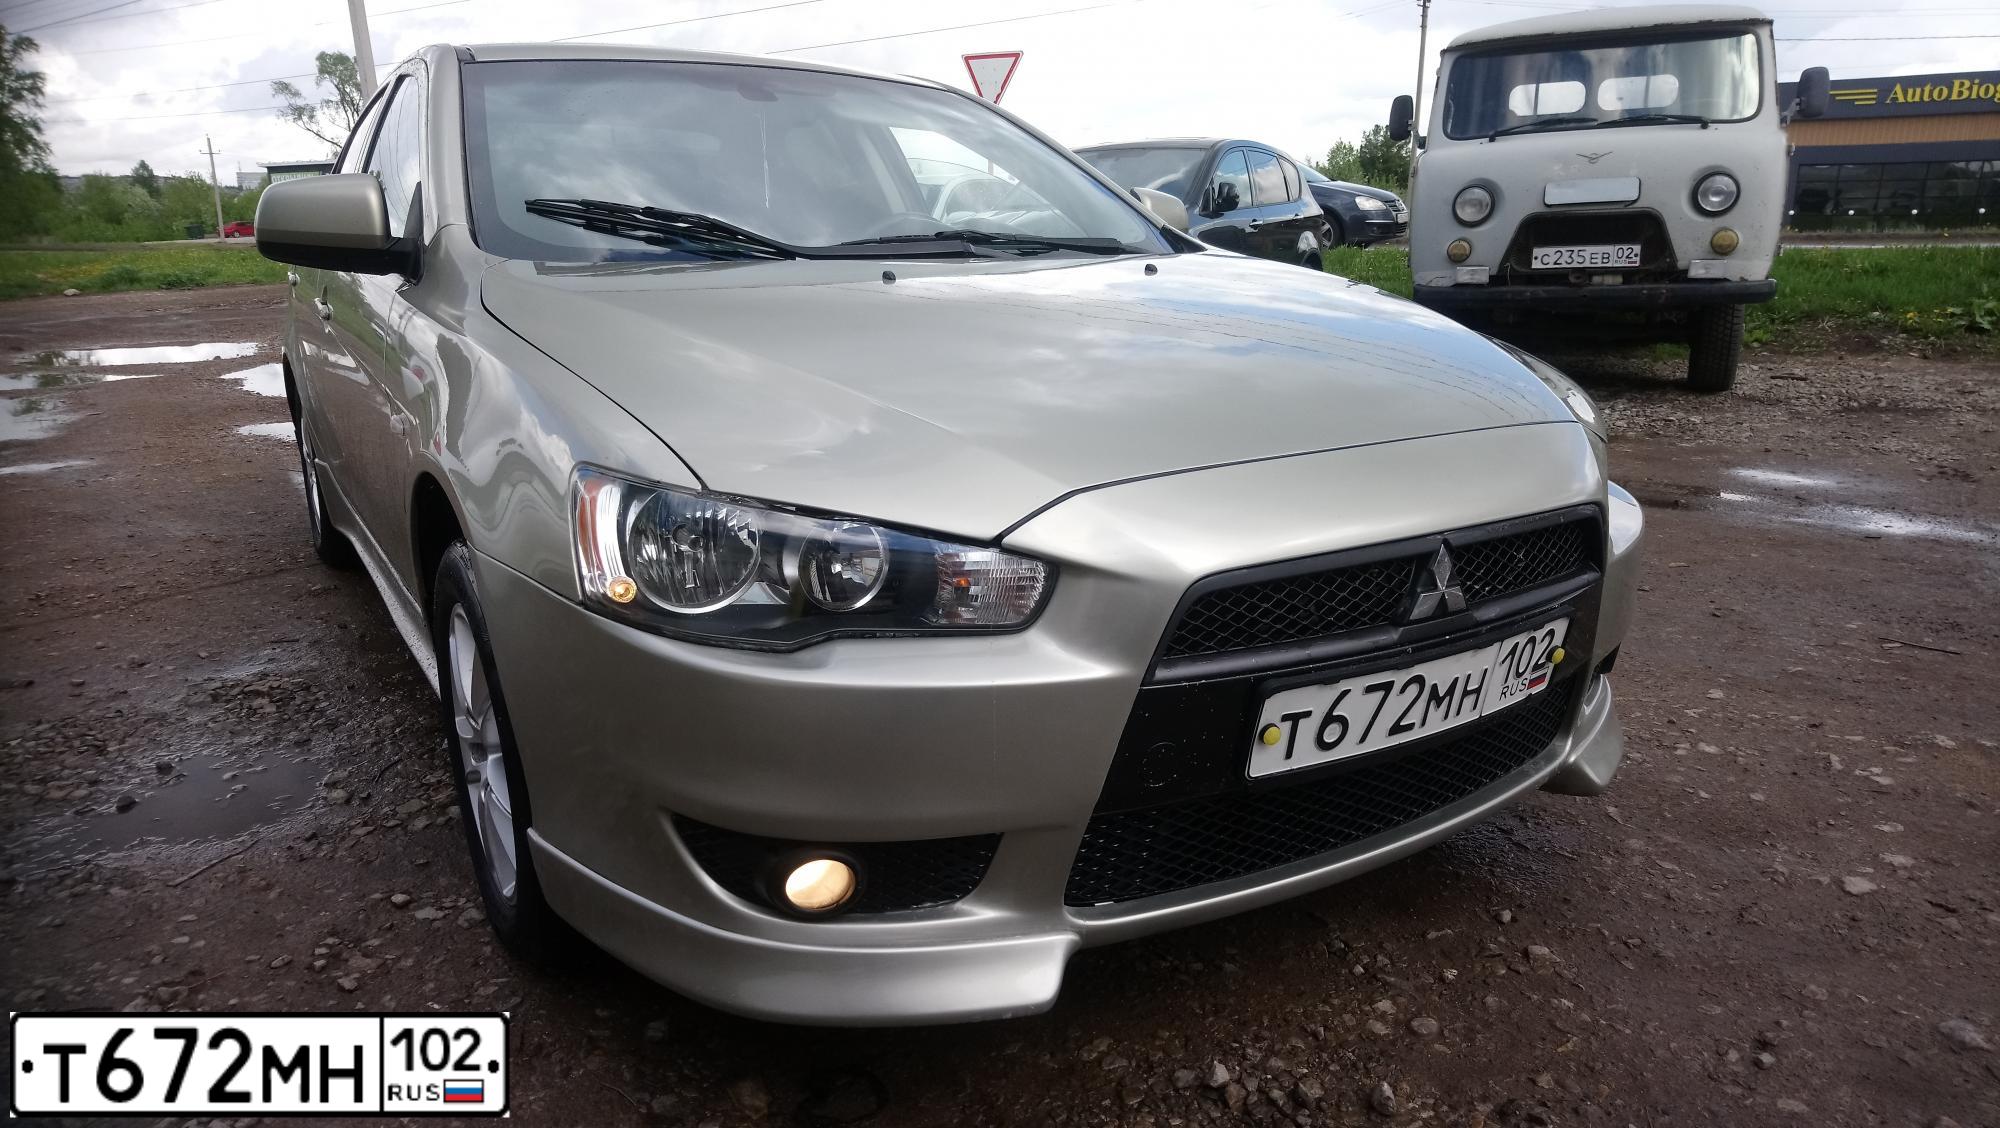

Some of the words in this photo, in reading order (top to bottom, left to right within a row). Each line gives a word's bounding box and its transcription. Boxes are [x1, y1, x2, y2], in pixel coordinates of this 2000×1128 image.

[1616, 246, 1634, 260] 02
[1501, 628, 1556, 685] 102
[1499, 677, 1528, 701] RUS
